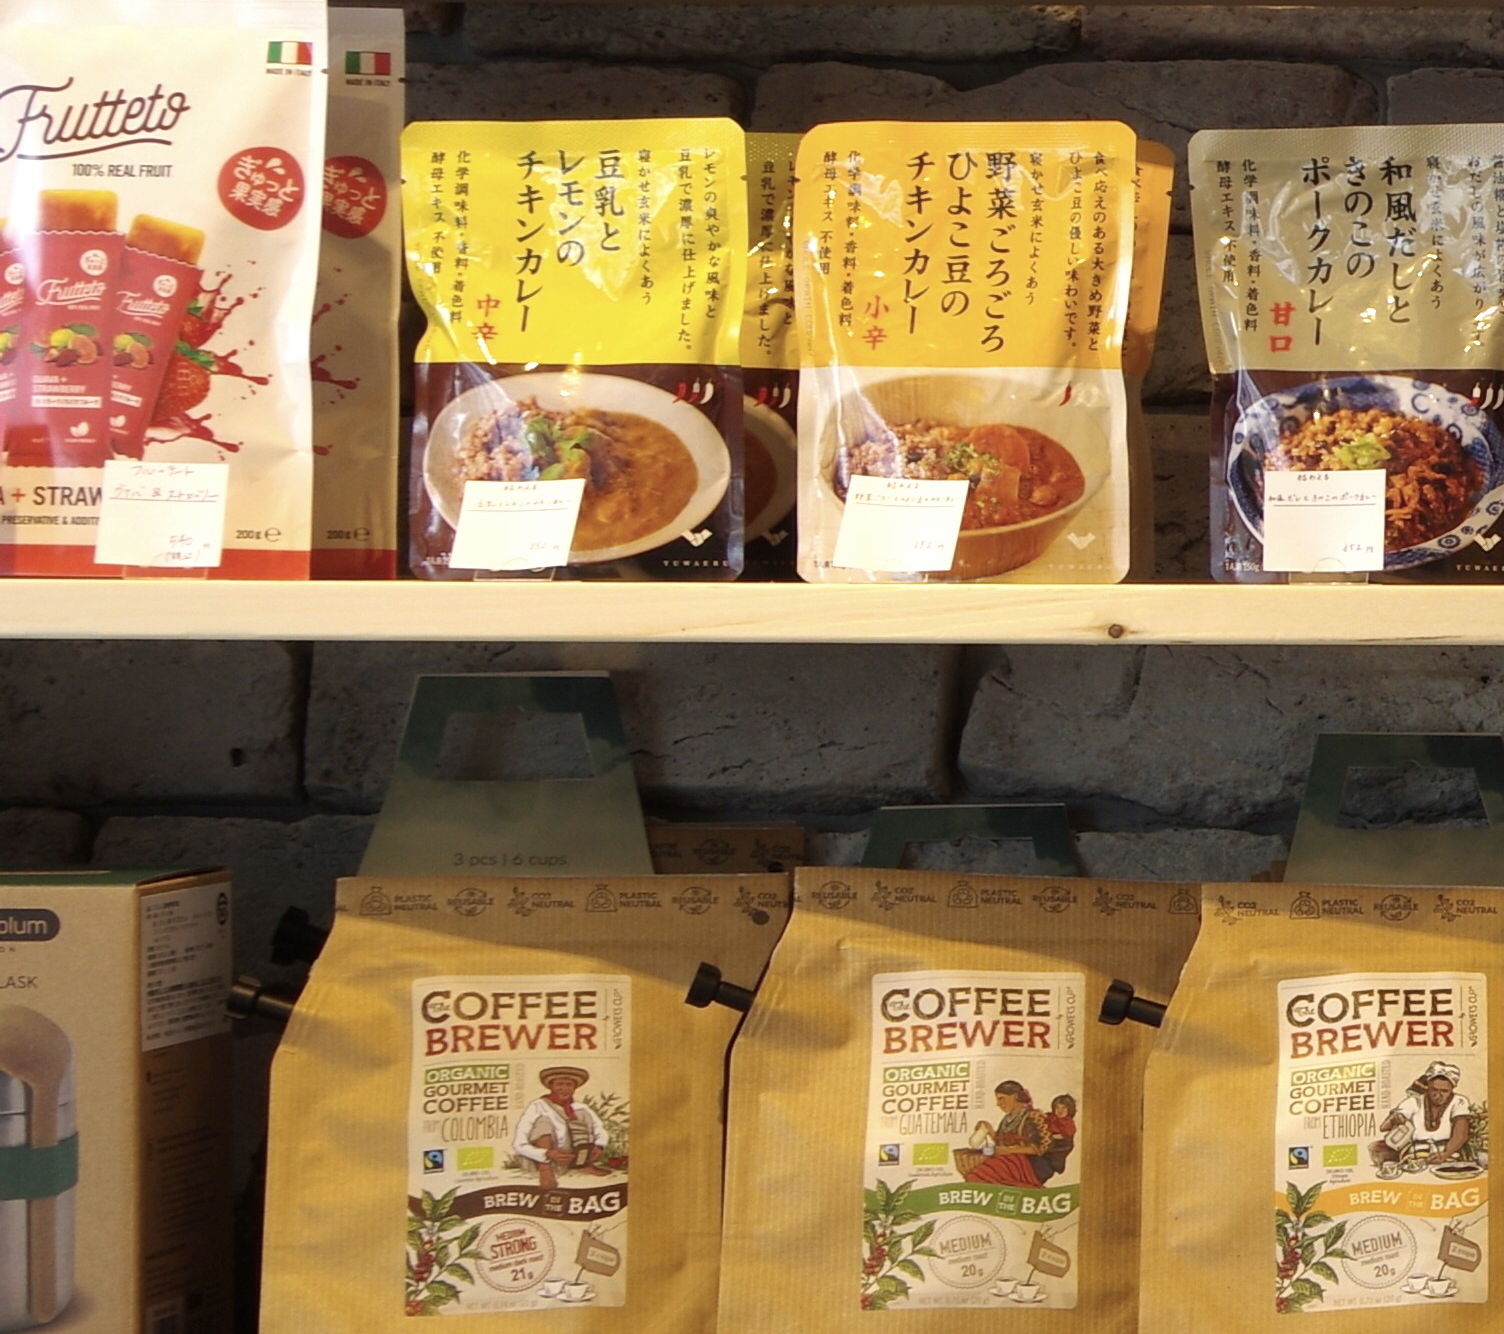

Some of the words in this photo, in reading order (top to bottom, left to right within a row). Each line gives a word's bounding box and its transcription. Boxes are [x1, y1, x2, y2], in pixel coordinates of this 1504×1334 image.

[0, 77, 191, 161] Frutteto
[73, 164, 104, 177] 100%
[108, 165, 135, 177] REAL
[139, 165, 172, 177] FRUIT
[557, 150, 584, 267] レモンの
[595, 149, 625, 251] 豆乳と
[1345, 156, 1375, 278] きのこの
[517, 151, 544, 332] チキンカレー
[904, 151, 935, 334] チキンカレー
[941, 153, 978, 316] ひよこ豆の
[1380, 157, 1416, 324] 和風だしと
[981, 152, 1017, 353] 野菜ごろごろ
[1302, 157, 1333, 346] ポークカレー
[36, 278, 107, 306] Frutteto
[472, 294, 500, 340] 中辛
[862, 296, 888, 350] 小辛
[1270, 301, 1295, 352] 甘口
[421, 990, 597, 1024] COFFEE
[881, 988, 1051, 1022] COFFEE
[1286, 989, 1453, 1027] COFFEE
[425, 1024, 597, 1057] BREWER
[883, 1020, 1051, 1054] BREWER
[1290, 1020, 1454, 1059] BREWER
[425, 1067, 509, 1083] ORGANIC
[884, 1064, 969, 1082] ORGANIC
[1292, 1065, 1375, 1085] ORGANIC
[424, 1083, 509, 1097] GOURMET
[882, 1080, 970, 1097] GOURMET
[1290, 1080, 1375, 1099] GOURMET
[423, 1097, 509, 1114] COFFEE
[882, 1095, 969, 1114] COFFEE
[1289, 1096, 1375, 1115] COFFEE
[442, 1116, 508, 1142] COLOMBIA
[900, 1112, 968, 1135] GUATEMALA
[1323, 1114, 1376, 1138] ETHIOPIA
[484, 1193, 539, 1209] BREW
[568, 1192, 620, 1214] BAG
[939, 1191, 993, 1205] BREW
[1021, 1193, 1071, 1214] BAG
[1350, 1191, 1401, 1205] BREW
[490, 1237, 537, 1259] STRONG
[940, 1233, 992, 1254] MEDIUM
[1351, 1232, 1402, 1255] MEDIUM
